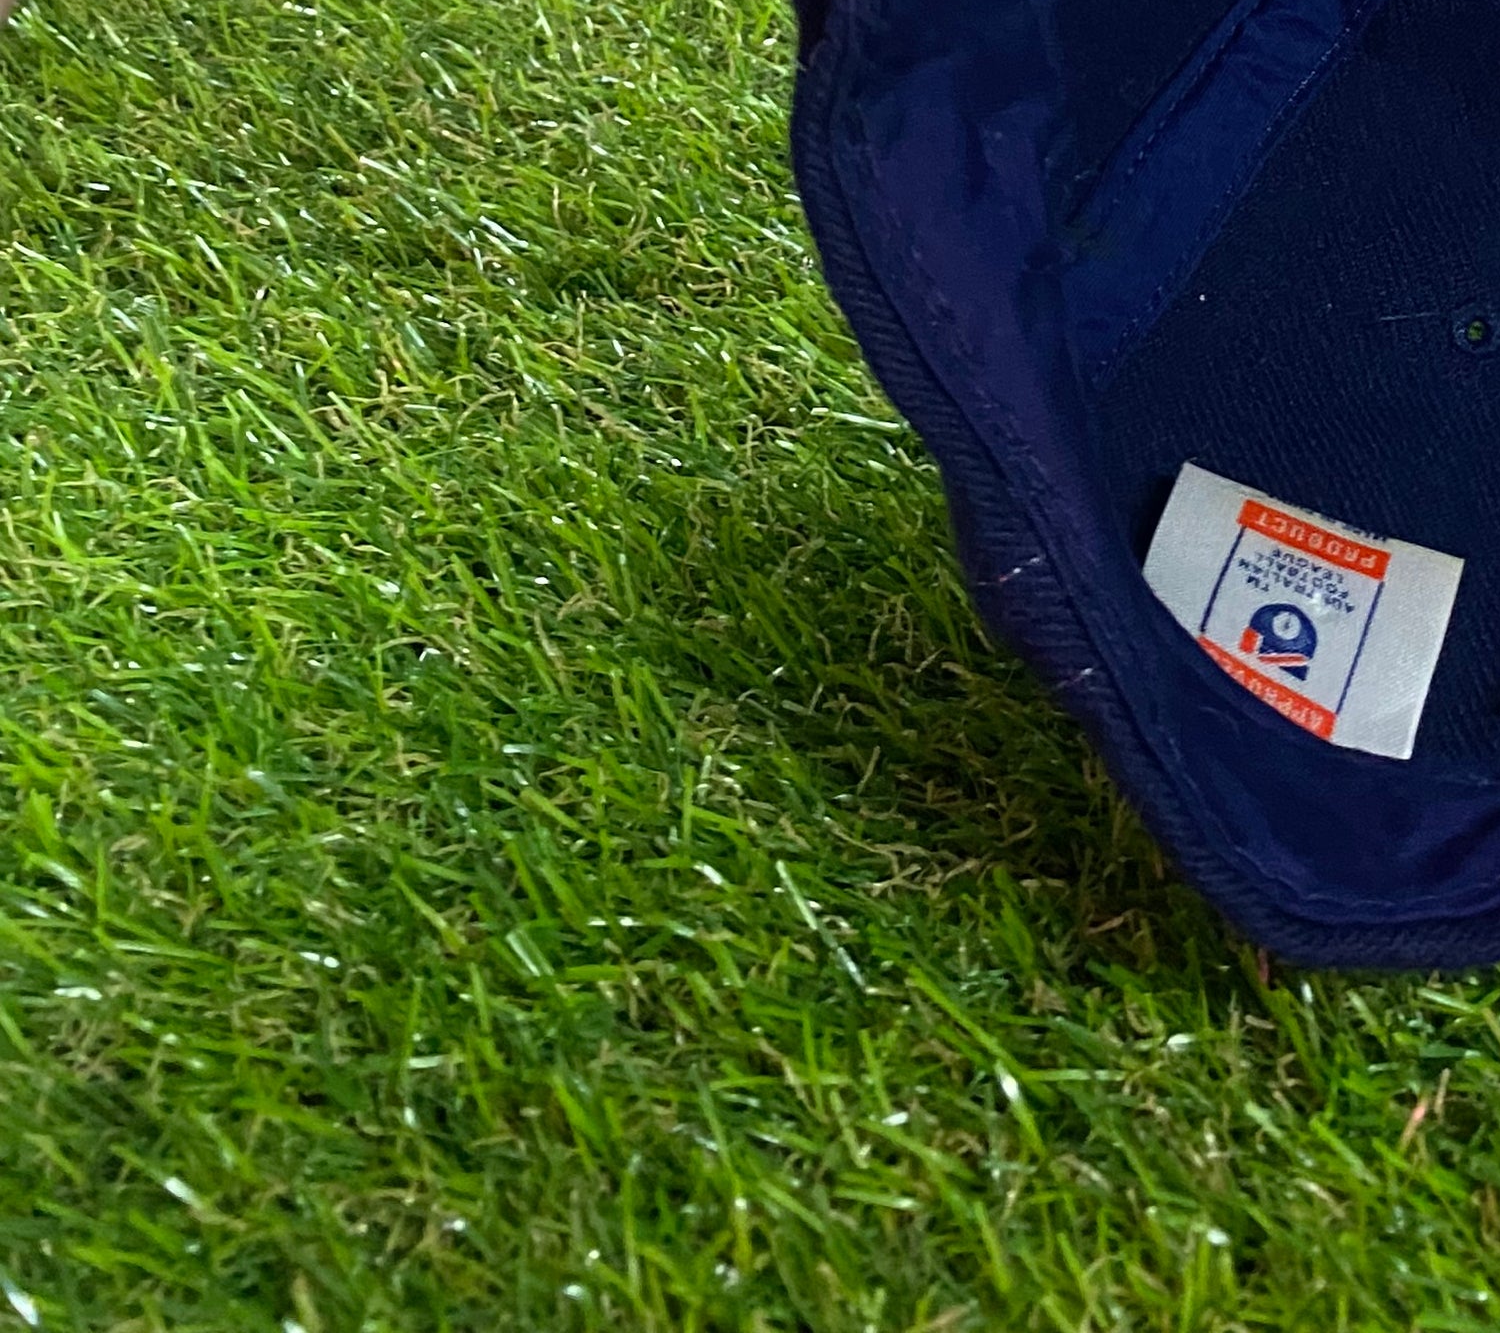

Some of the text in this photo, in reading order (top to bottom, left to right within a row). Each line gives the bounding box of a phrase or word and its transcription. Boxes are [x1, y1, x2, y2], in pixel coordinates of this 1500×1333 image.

[1256, 510, 1378, 569] PRODUCT
[1272, 548, 1344, 583] LEAGUE
[1256, 552, 1350, 599] FOOTBALL
[1210, 651, 1326, 730] APPROVE
